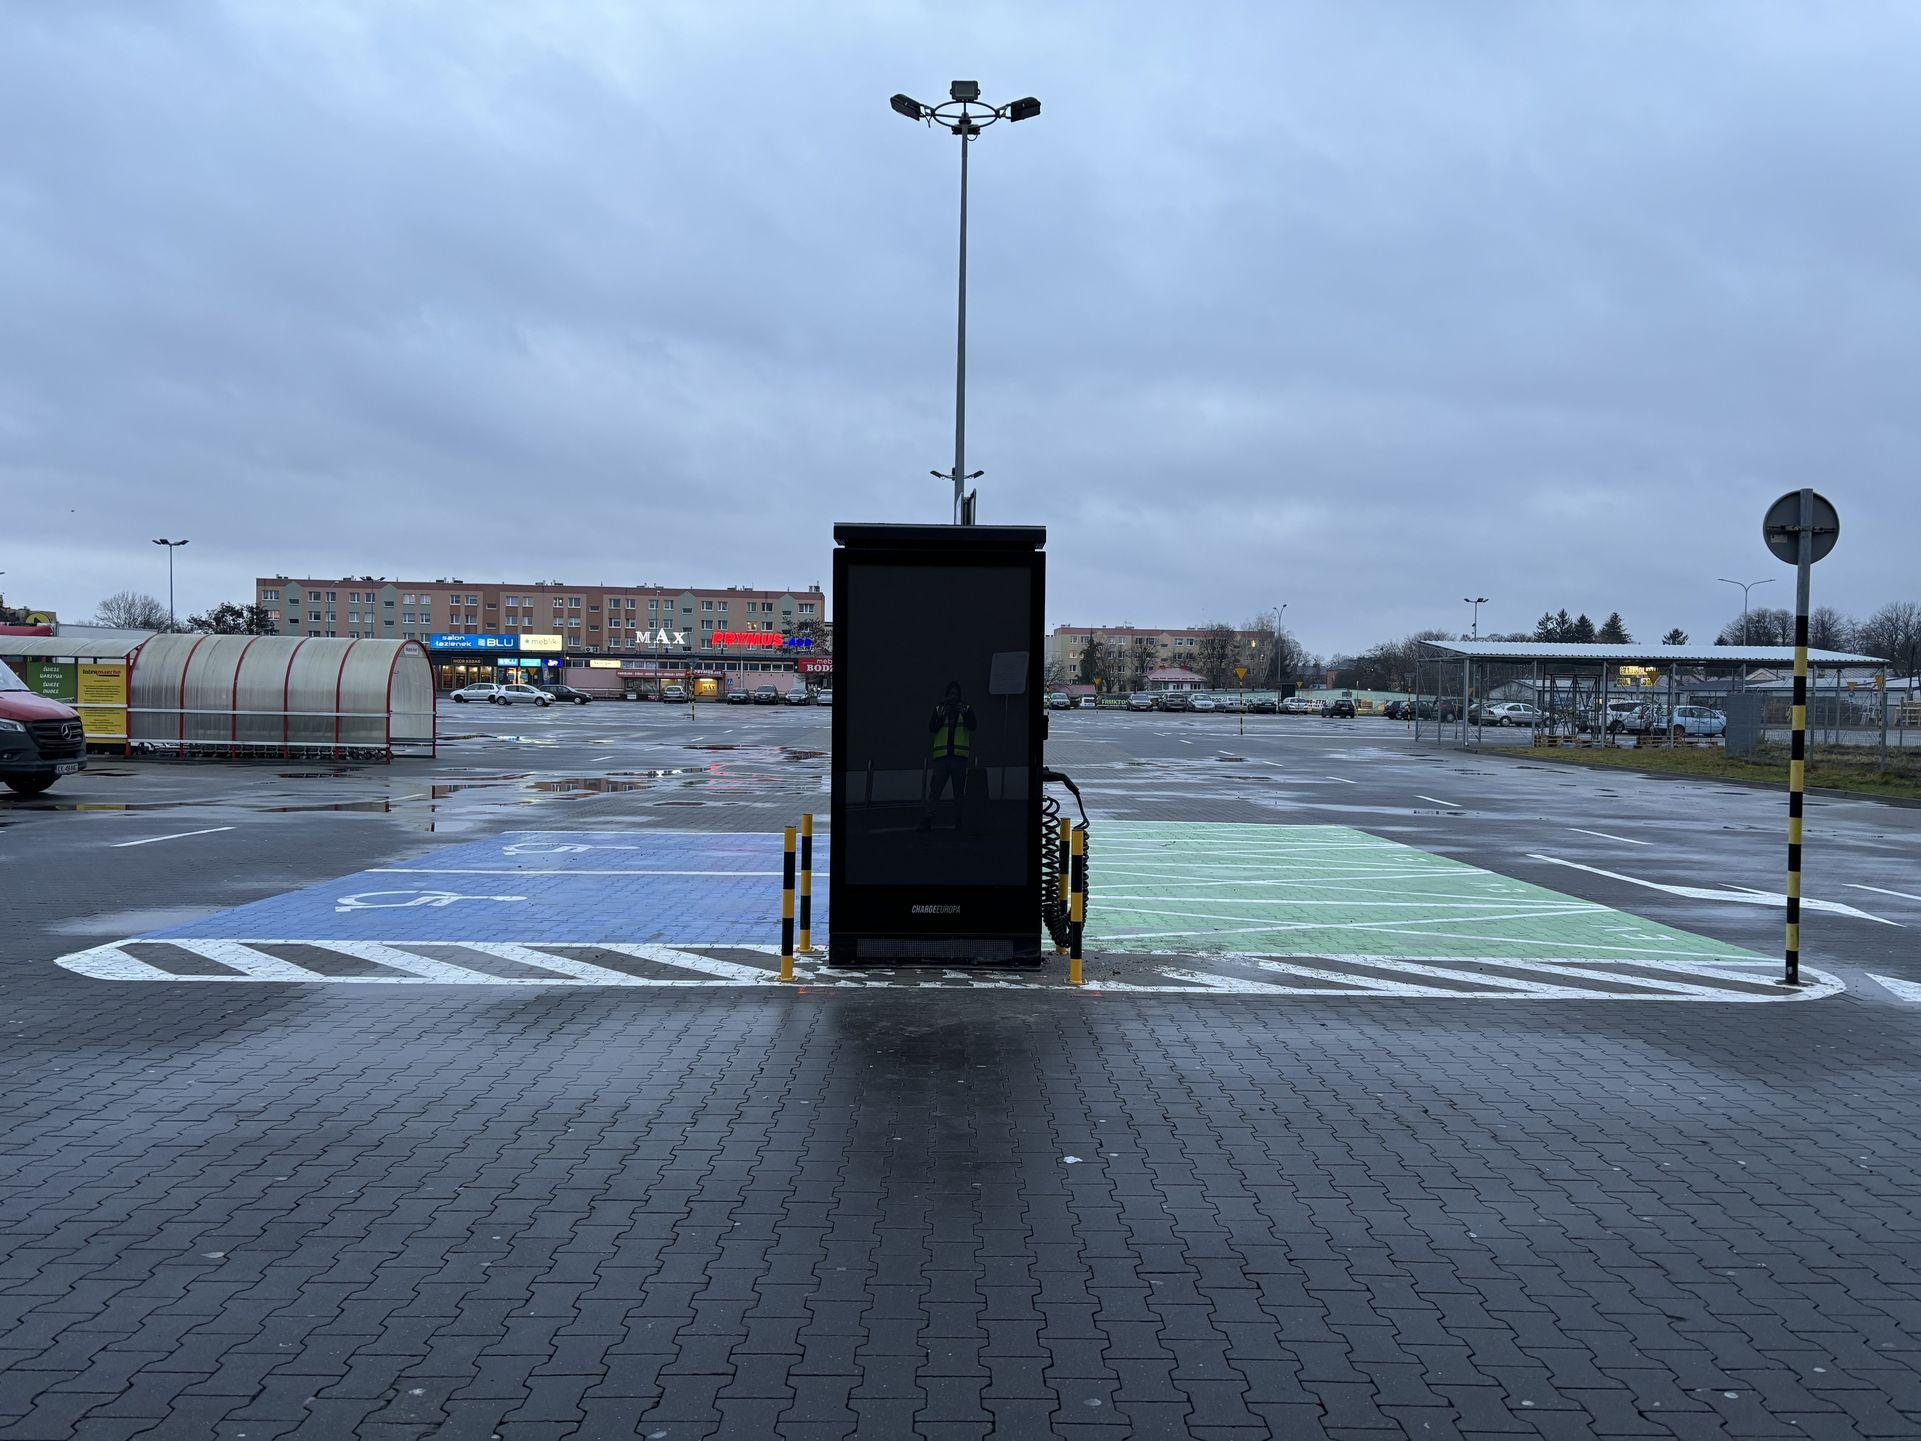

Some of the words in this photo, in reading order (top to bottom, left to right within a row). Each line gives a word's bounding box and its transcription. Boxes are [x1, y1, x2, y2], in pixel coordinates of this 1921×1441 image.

[486, 638, 514, 647] BLU
[635, 628, 686, 645] MAX
[712, 631, 784, 647] PRYMUS
[911, 904, 961, 914] CHARGEEUROPA
